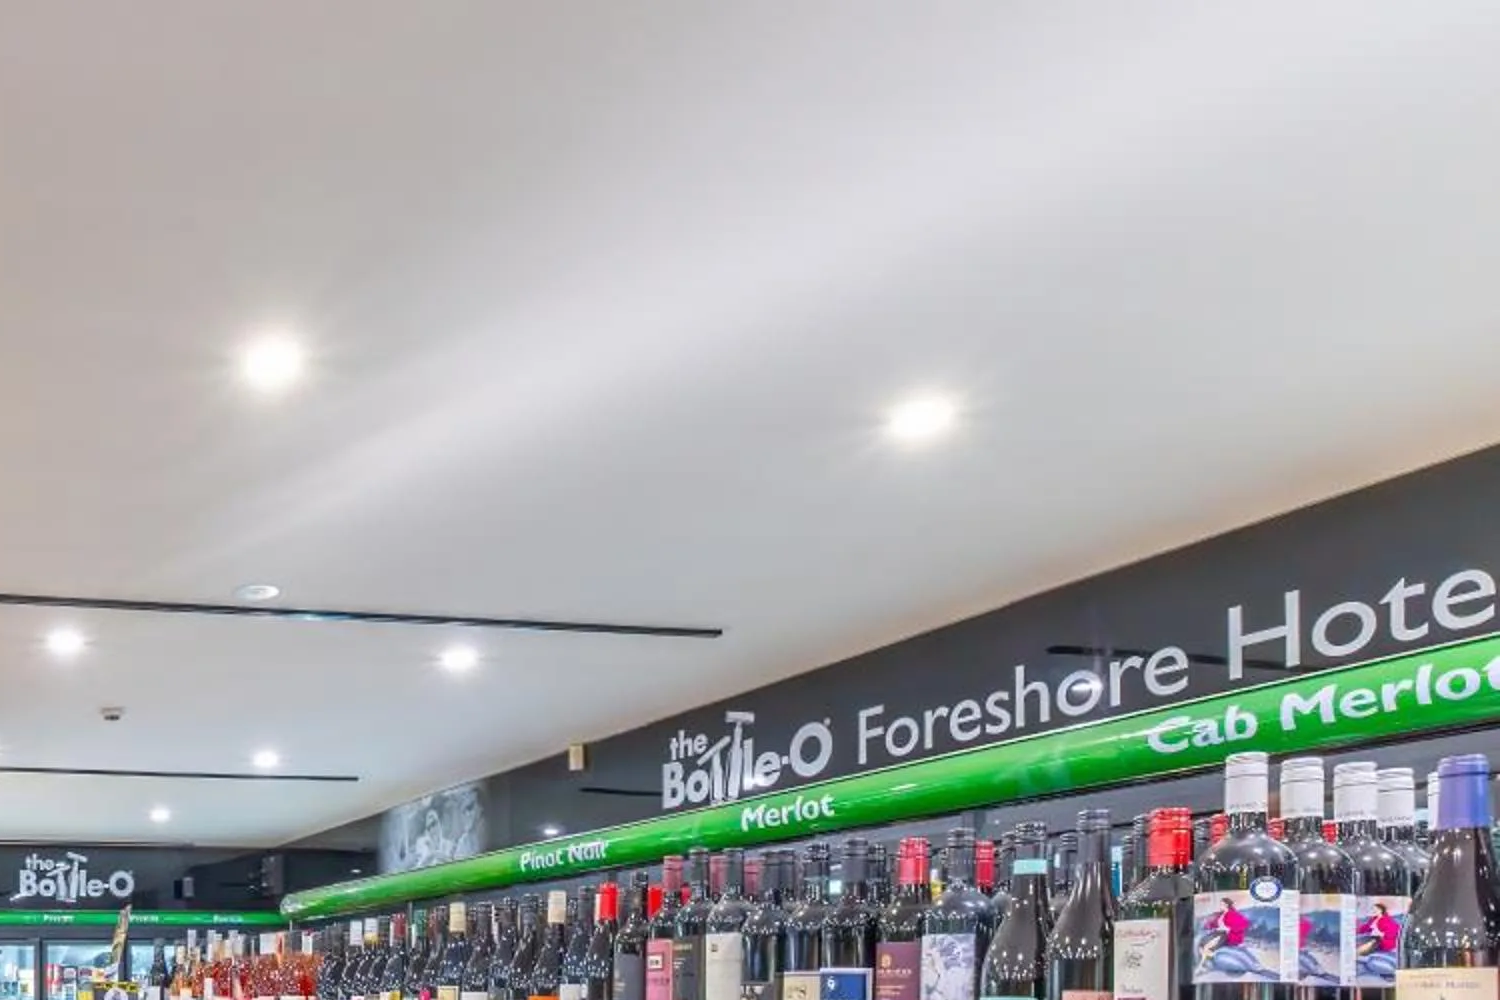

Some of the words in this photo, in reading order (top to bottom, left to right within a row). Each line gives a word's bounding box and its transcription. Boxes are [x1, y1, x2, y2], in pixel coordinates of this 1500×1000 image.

[857, 646, 1189, 765] Foreshore
[1228, 569, 1496, 681] Hote
[669, 731, 708, 761] the
[1147, 706, 1258, 754] Cab
[741, 793, 835, 832] Merlot
[25, 854, 54, 871] the
[520, 849, 564, 871] Pinot
[566, 840, 609, 861] Noir
